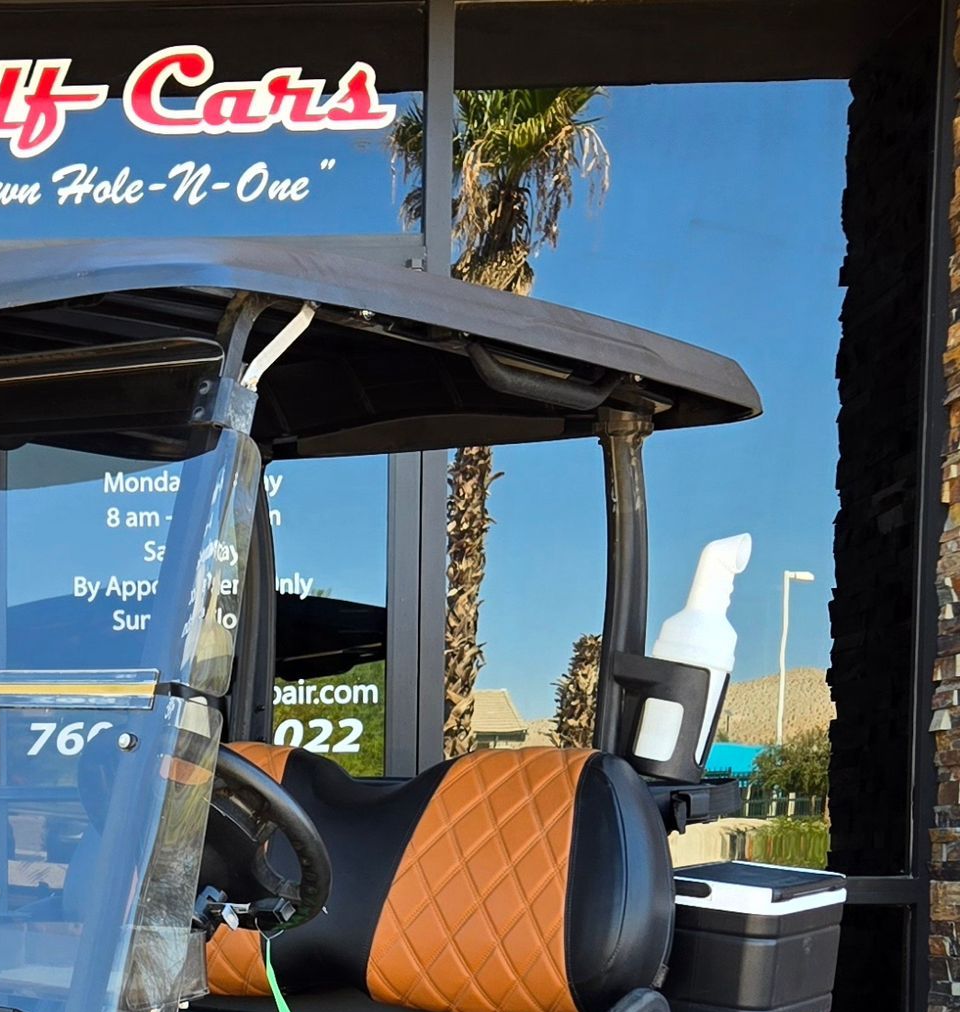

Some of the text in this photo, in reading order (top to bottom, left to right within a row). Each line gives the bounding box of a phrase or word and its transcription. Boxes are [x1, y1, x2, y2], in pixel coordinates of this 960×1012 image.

[123, 44, 397, 135] Cars
[103, 470, 181, 494] Monda
[106, 506, 121, 528] 8
[125, 509, 161, 528] am
[73, 575, 101, 603] By
[273, 718, 364, 753] 022
